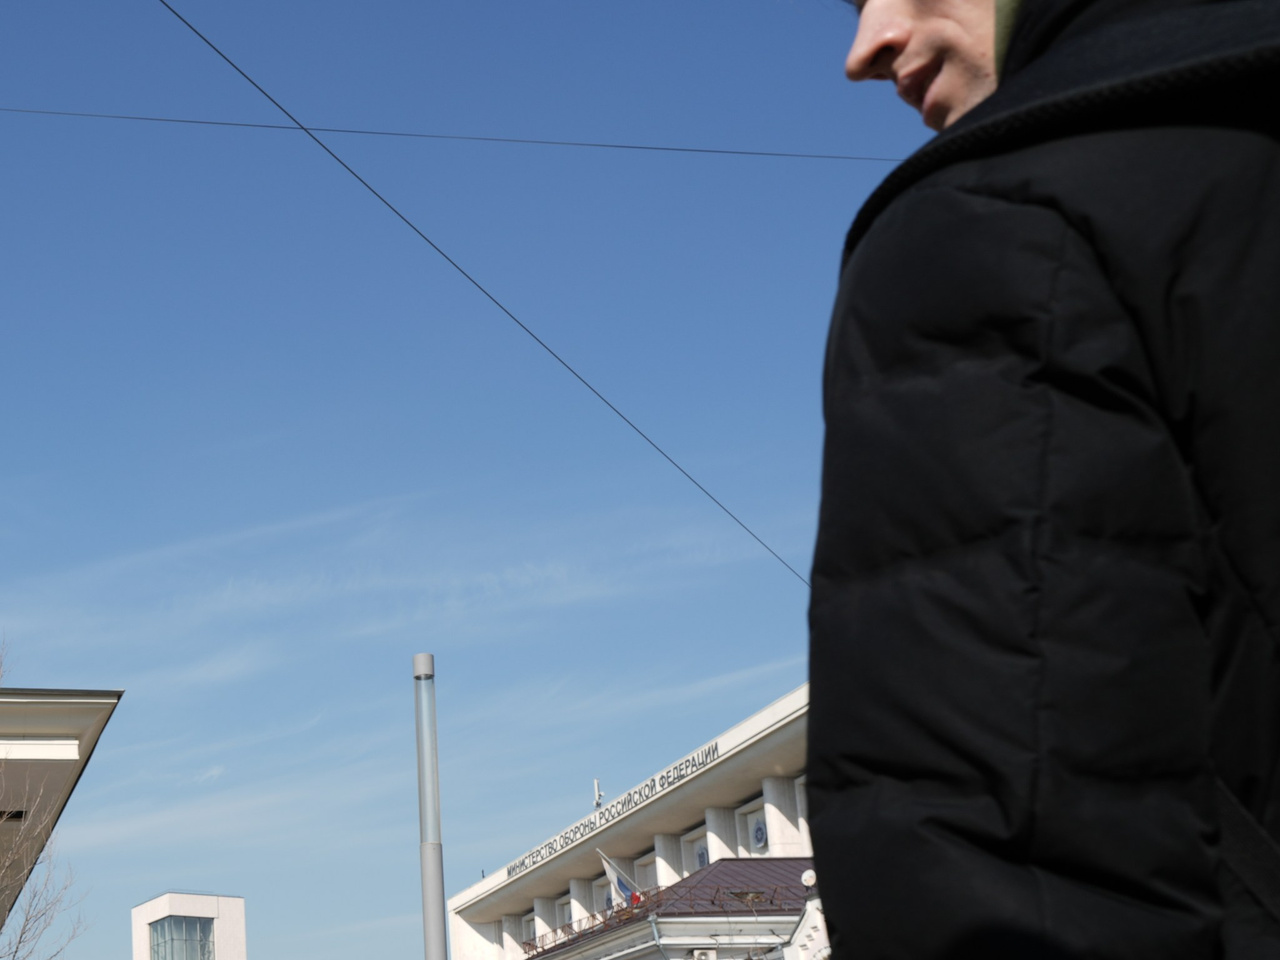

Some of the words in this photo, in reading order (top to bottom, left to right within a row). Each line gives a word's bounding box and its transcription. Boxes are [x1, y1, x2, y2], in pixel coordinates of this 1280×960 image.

[506, 839, 558, 877] МИНИСТЕРСТВО
[559, 817, 598, 847] ОБОРОНЫ
[599, 778, 656, 826] РОССИЙСКОЙ
[659, 742, 719, 790] ФЕДЕРАЦИИ
